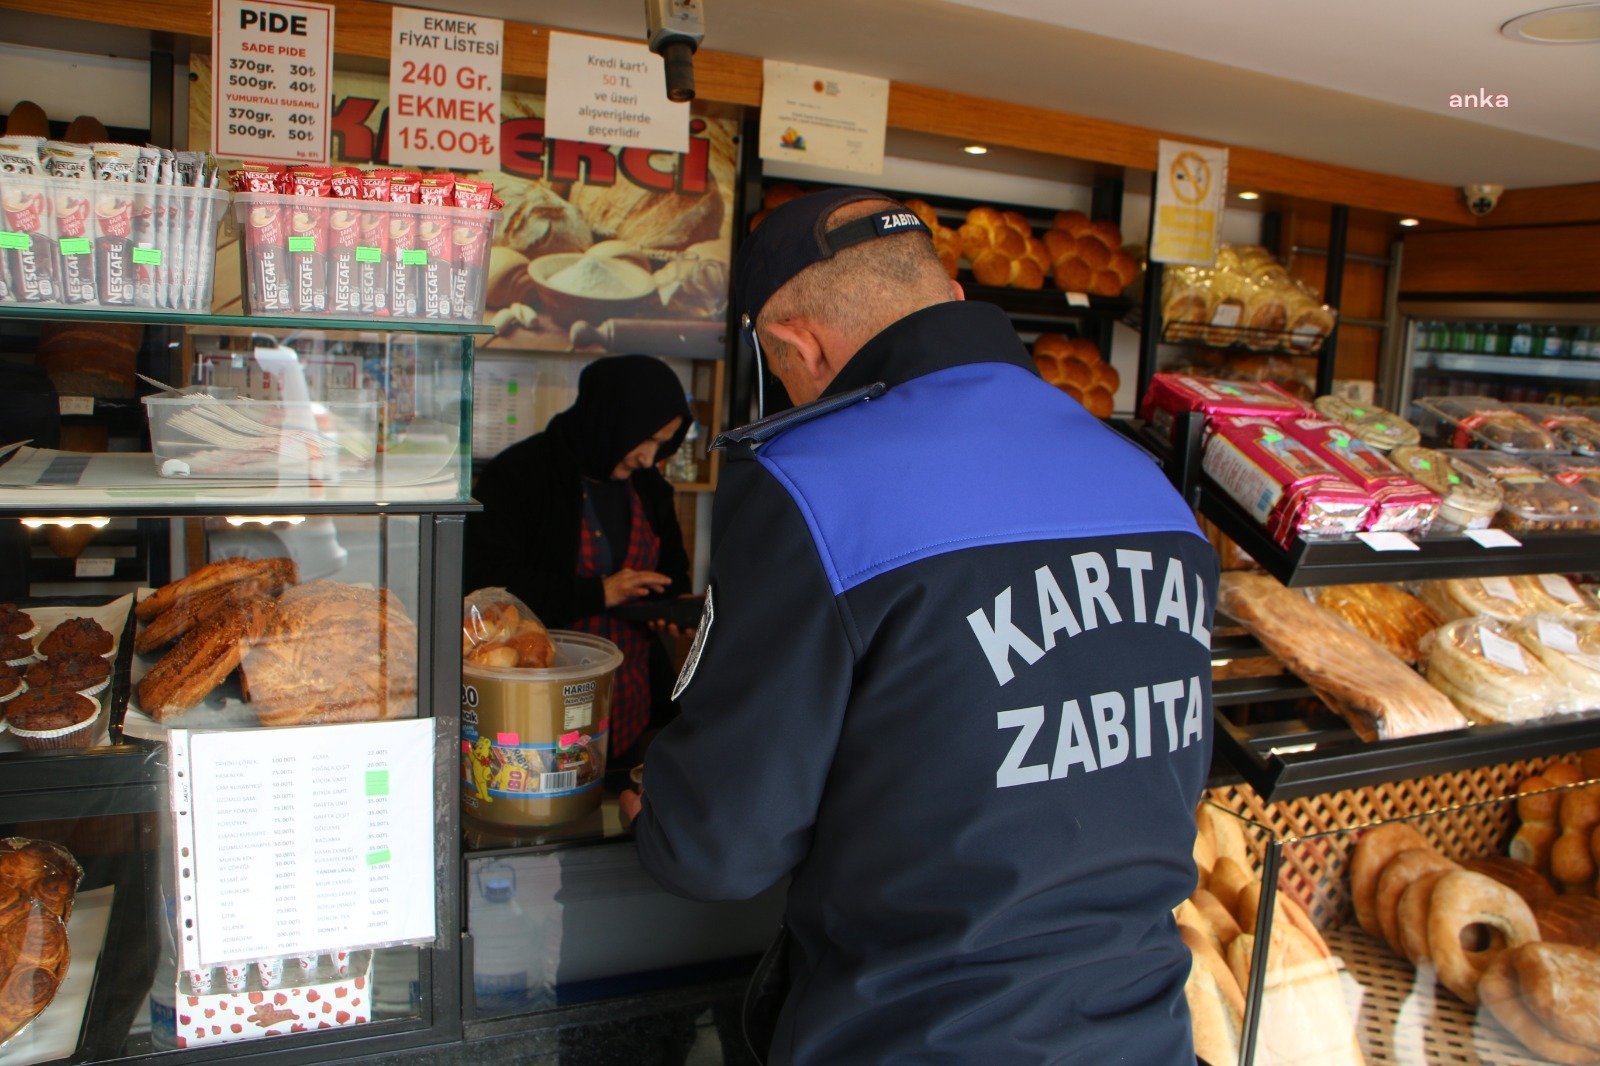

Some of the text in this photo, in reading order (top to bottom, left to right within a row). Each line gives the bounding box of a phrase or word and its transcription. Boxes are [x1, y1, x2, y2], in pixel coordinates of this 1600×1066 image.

[424, 16, 477, 35] EKMEK
[242, 42, 275, 54] SADE
[400, 30, 499, 56] FİYAT LİSTESİ
[229, 58, 274, 74] 370gr.
[588, 54, 616, 68] Kredi
[229, 75, 276, 90] 500gr.
[402, 60, 491, 91] 240 Gr.
[603, 74, 631, 88] 50 TL
[226, 93, 319, 109] YUMURTALI SUSAMLI
[594, 92, 637, 105] ve üzeri
[229, 108, 273, 122] 370gr.
[398, 94, 496, 124] EKMEK
[579, 106, 651, 124] alışverişlerde
[228, 124, 275, 139] 500gr.
[588, 125, 640, 138] geçerlidir
[966, 548, 1211, 686] KARTAL
[564, 681, 597, 696] HARIBO
[996, 676, 1202, 788] ZABITA
